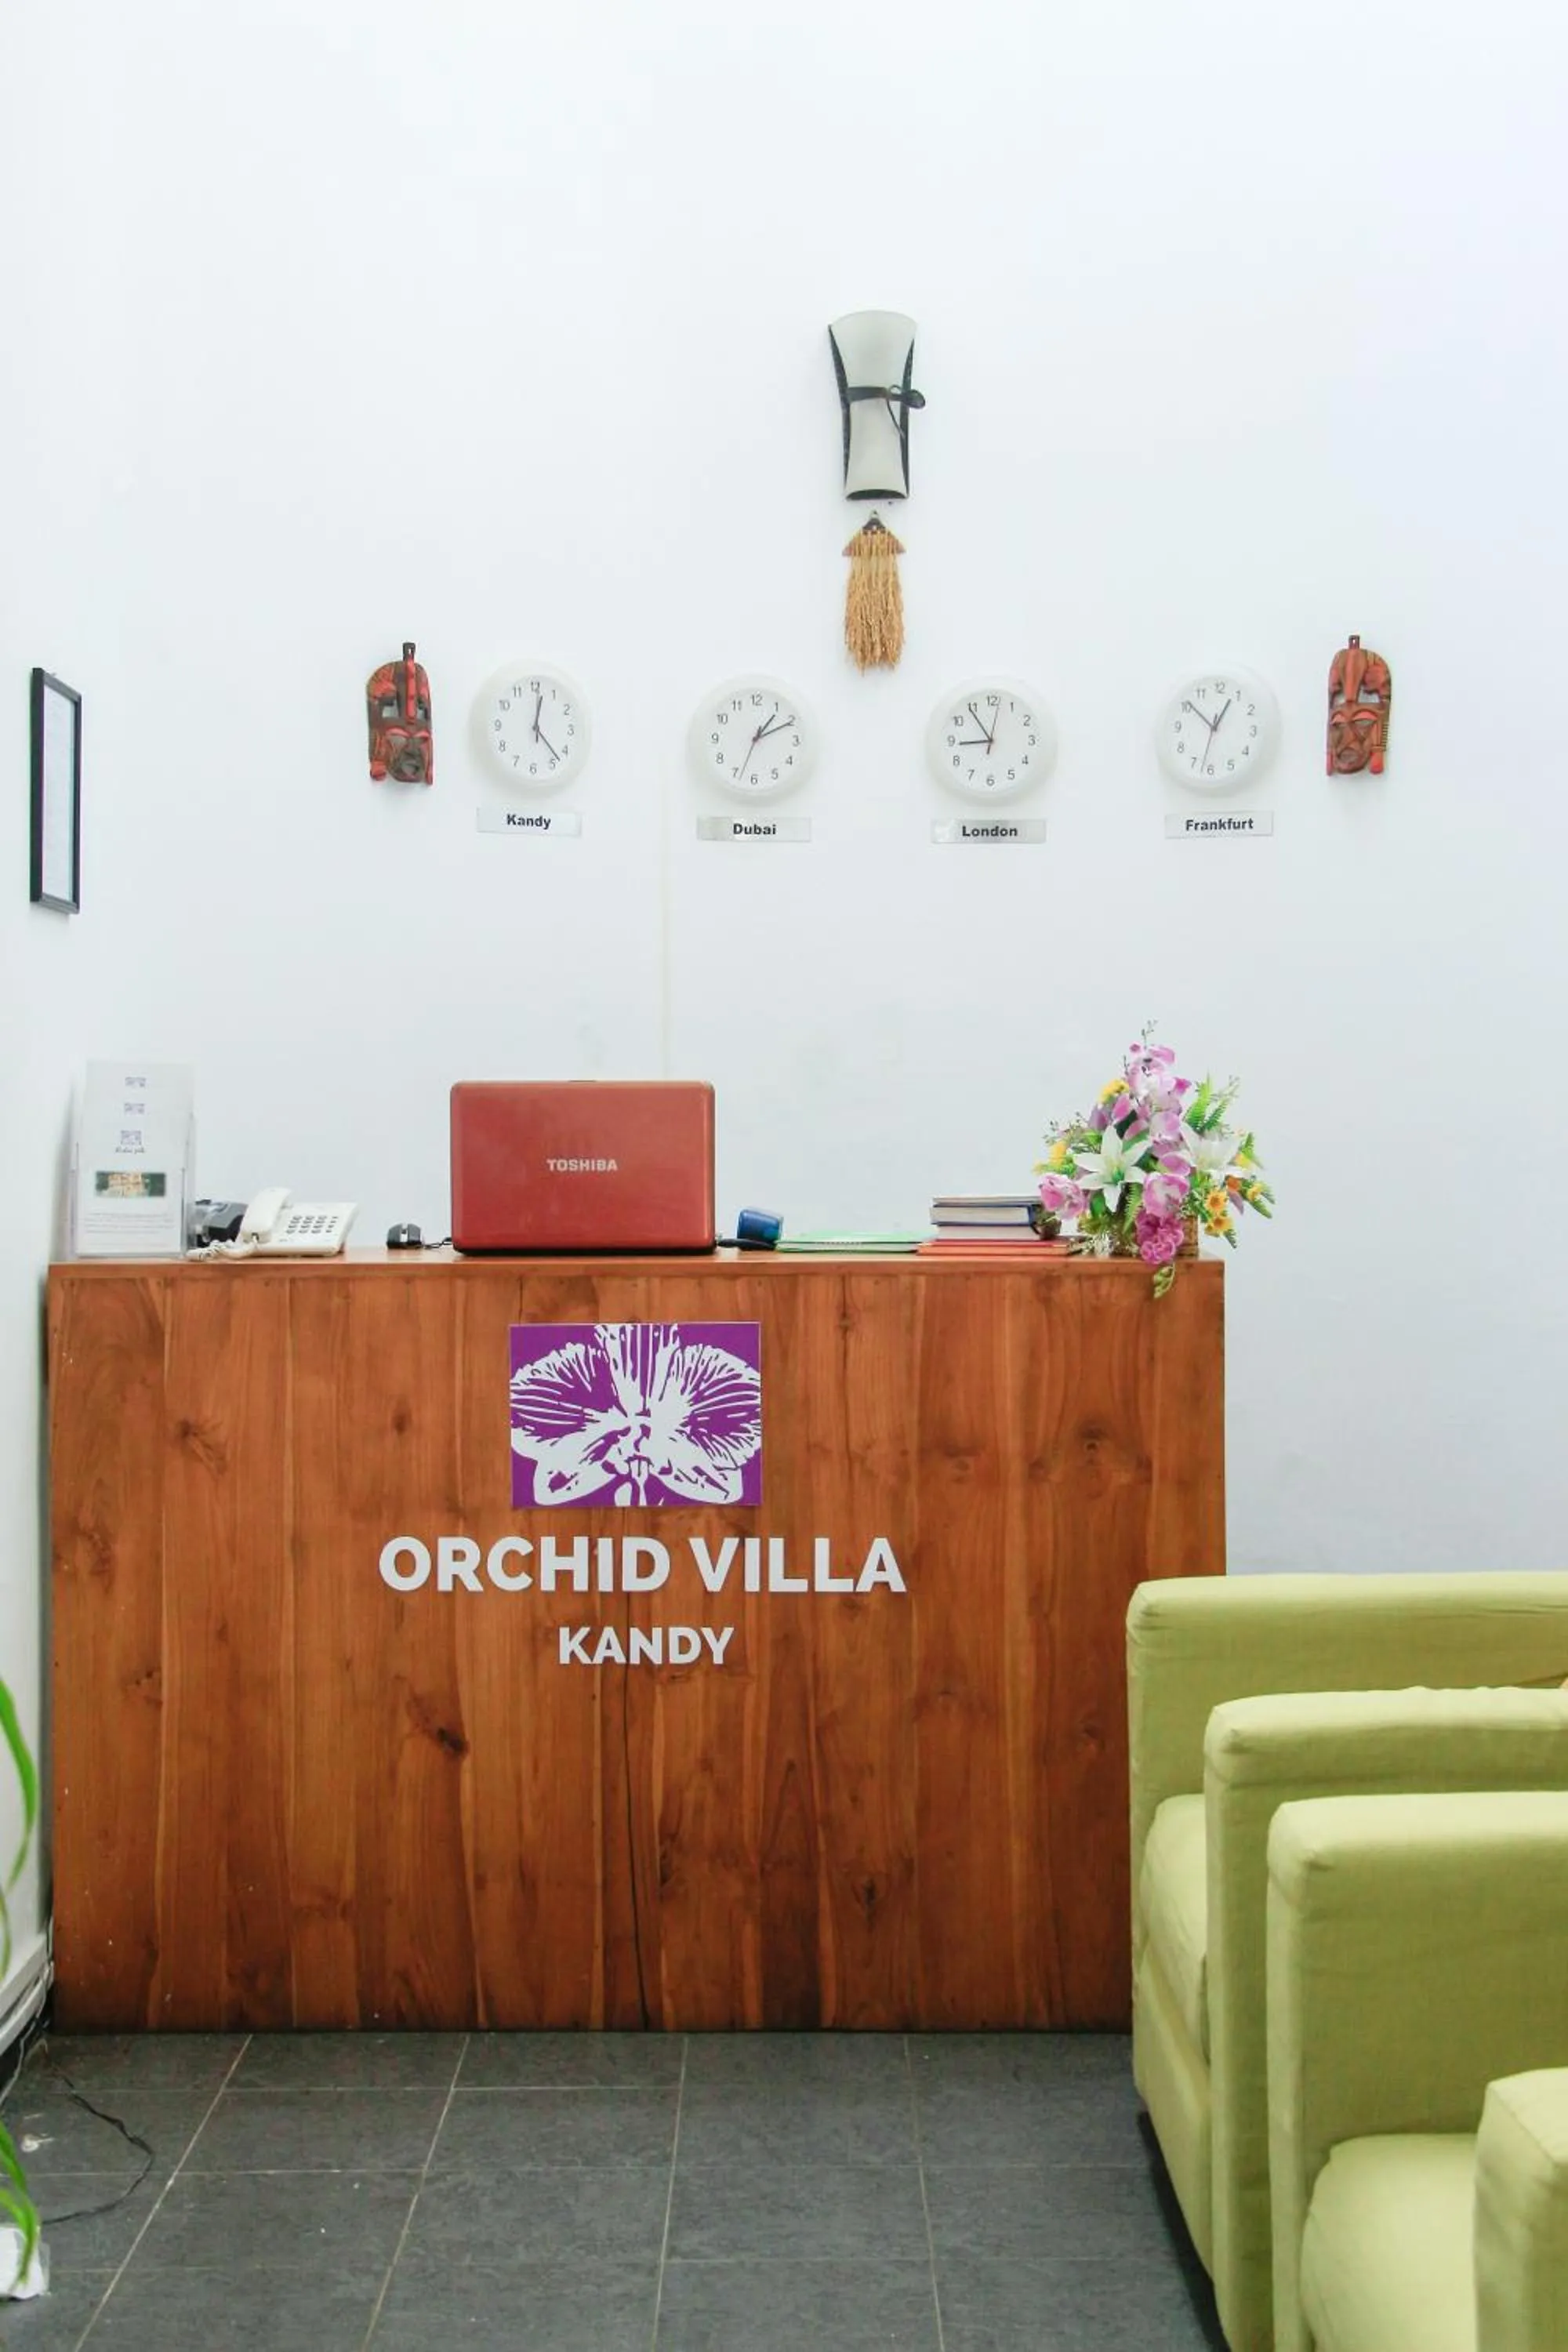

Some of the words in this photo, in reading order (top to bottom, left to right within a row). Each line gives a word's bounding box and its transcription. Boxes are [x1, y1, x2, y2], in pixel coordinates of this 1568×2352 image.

[513, 686, 521, 698] 11
[1196, 688, 1205, 699] 11
[1215, 682, 1225, 694] 12
[552, 689, 556, 700] 1
[750, 694, 763, 706] 12
[1236, 691, 1241, 701] 1
[499, 699, 510, 710] 10
[732, 700, 742, 711] 11
[986, 695, 998, 706] 12
[564, 704, 570, 715] 2
[775, 702, 779, 712] 1
[1010, 702, 1014, 713] 1
[1247, 704, 1255, 715] 2
[717, 713, 728, 724] 10
[788, 715, 795, 726] 2
[953, 716, 964, 726] 10
[1024, 715, 1031, 726] 2
[495, 719, 502, 731] 9
[568, 724, 574, 736] 3
[1175, 721, 1181, 732] 9
[1250, 725, 1257, 737] 3
[711, 733, 719, 744] 9
[793, 735, 800, 746] 3
[948, 735, 956, 746] 9
[1028, 735, 1036, 746] 3
[499, 741, 506, 752] 8
[562, 746, 568, 756] 4
[1177, 742, 1184, 753] 8
[1242, 746, 1249, 756] 4
[514, 755, 519, 766] 7
[550, 759, 555, 769] 5
[716, 753, 724, 764] 8
[786, 756, 793, 765] 4
[953, 756, 960, 766] 8
[1022, 756, 1028, 764] 4
[1191, 757, 1197, 768] 7
[529, 763, 537, 775] 6
[1207, 765, 1214, 775] 6
[1227, 760, 1235, 771] 5
[732, 768, 739, 778] 7
[771, 768, 779, 779] 5
[968, 769, 975, 780] 7
[1007, 770, 1014, 780] 5
[751, 774, 758, 785] 6
[986, 775, 994, 786] 6
[506, 813, 551, 830] Kandy
[1185, 818, 1254, 831] Frankfurt
[733, 822, 776, 835] Dubai
[962, 825, 1018, 837] London
[546, 1159, 618, 1172] TOSHIBA
[379, 1536, 670, 1592] ORCHID
[689, 1537, 907, 1592] VILLA
[558, 1627, 735, 1664] KANDY
